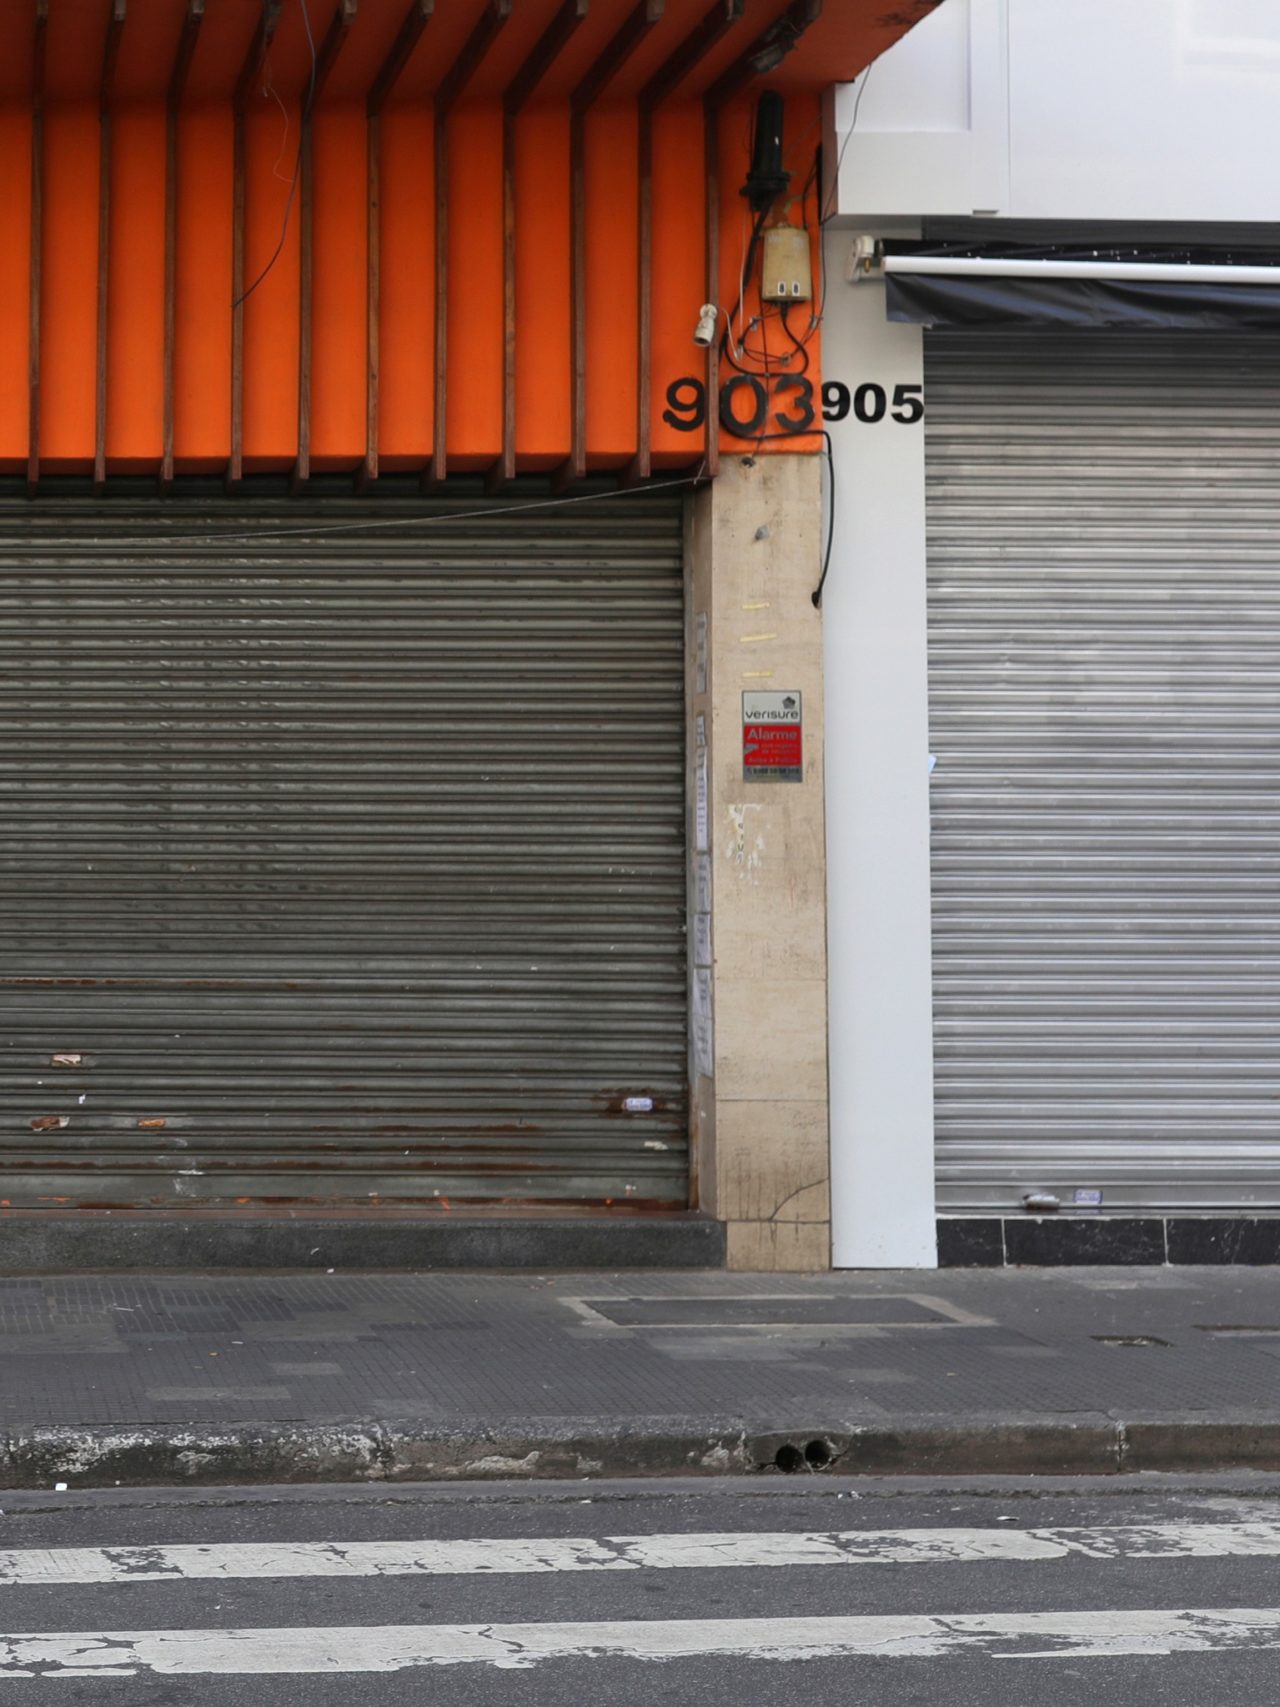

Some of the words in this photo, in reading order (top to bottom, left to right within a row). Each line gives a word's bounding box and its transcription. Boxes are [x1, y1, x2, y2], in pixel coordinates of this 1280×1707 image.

[663, 374, 816, 433] 903
[821, 381, 924, 424] 905
[744, 709, 799, 721] verisure
[747, 727, 798, 740] Alarme
